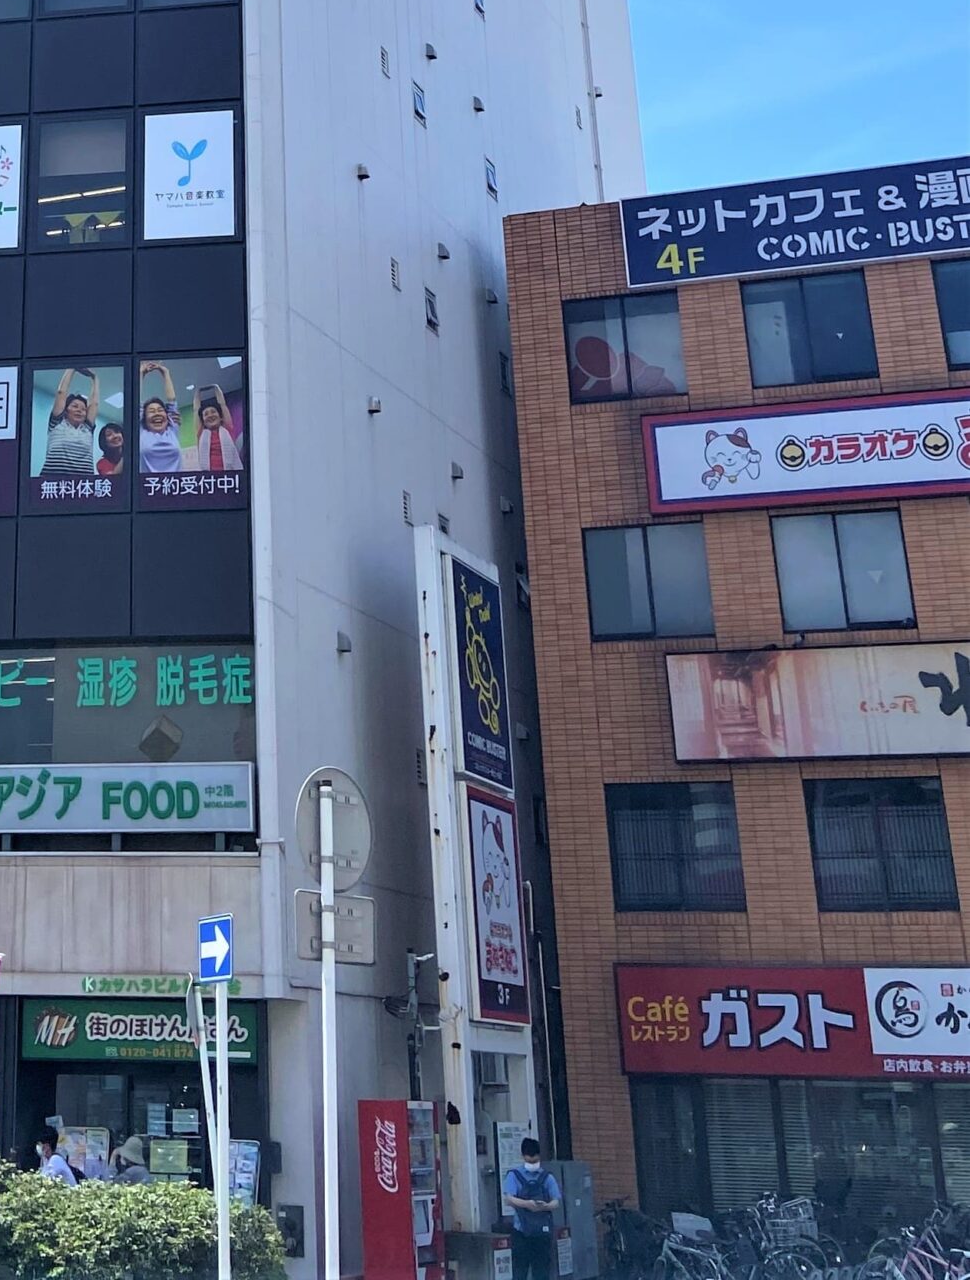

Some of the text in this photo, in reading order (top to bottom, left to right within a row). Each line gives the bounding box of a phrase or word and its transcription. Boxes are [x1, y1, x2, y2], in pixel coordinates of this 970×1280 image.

[155, 188, 226, 203] ヤマハ音楽教室
[637, 187, 864, 240] ネットカフェ
[877, 185, 907, 210] &
[656, 243, 705, 275] 4F
[807, 430, 918, 464] カラオケ
[40, 479, 112, 499] 無料体験
[143, 474, 240, 497] 予約受付中!
[76, 655, 138, 708] 湿疹
[156, 652, 253, 708] 脱毛症
[101, 780, 200, 821] FOOD
[627, 996, 690, 1023] Café
[701, 989, 854, 1049] ガスト
[86, 1012, 249, 1042] 街のほけんさん
[630, 1024, 691, 1042] レストラン
